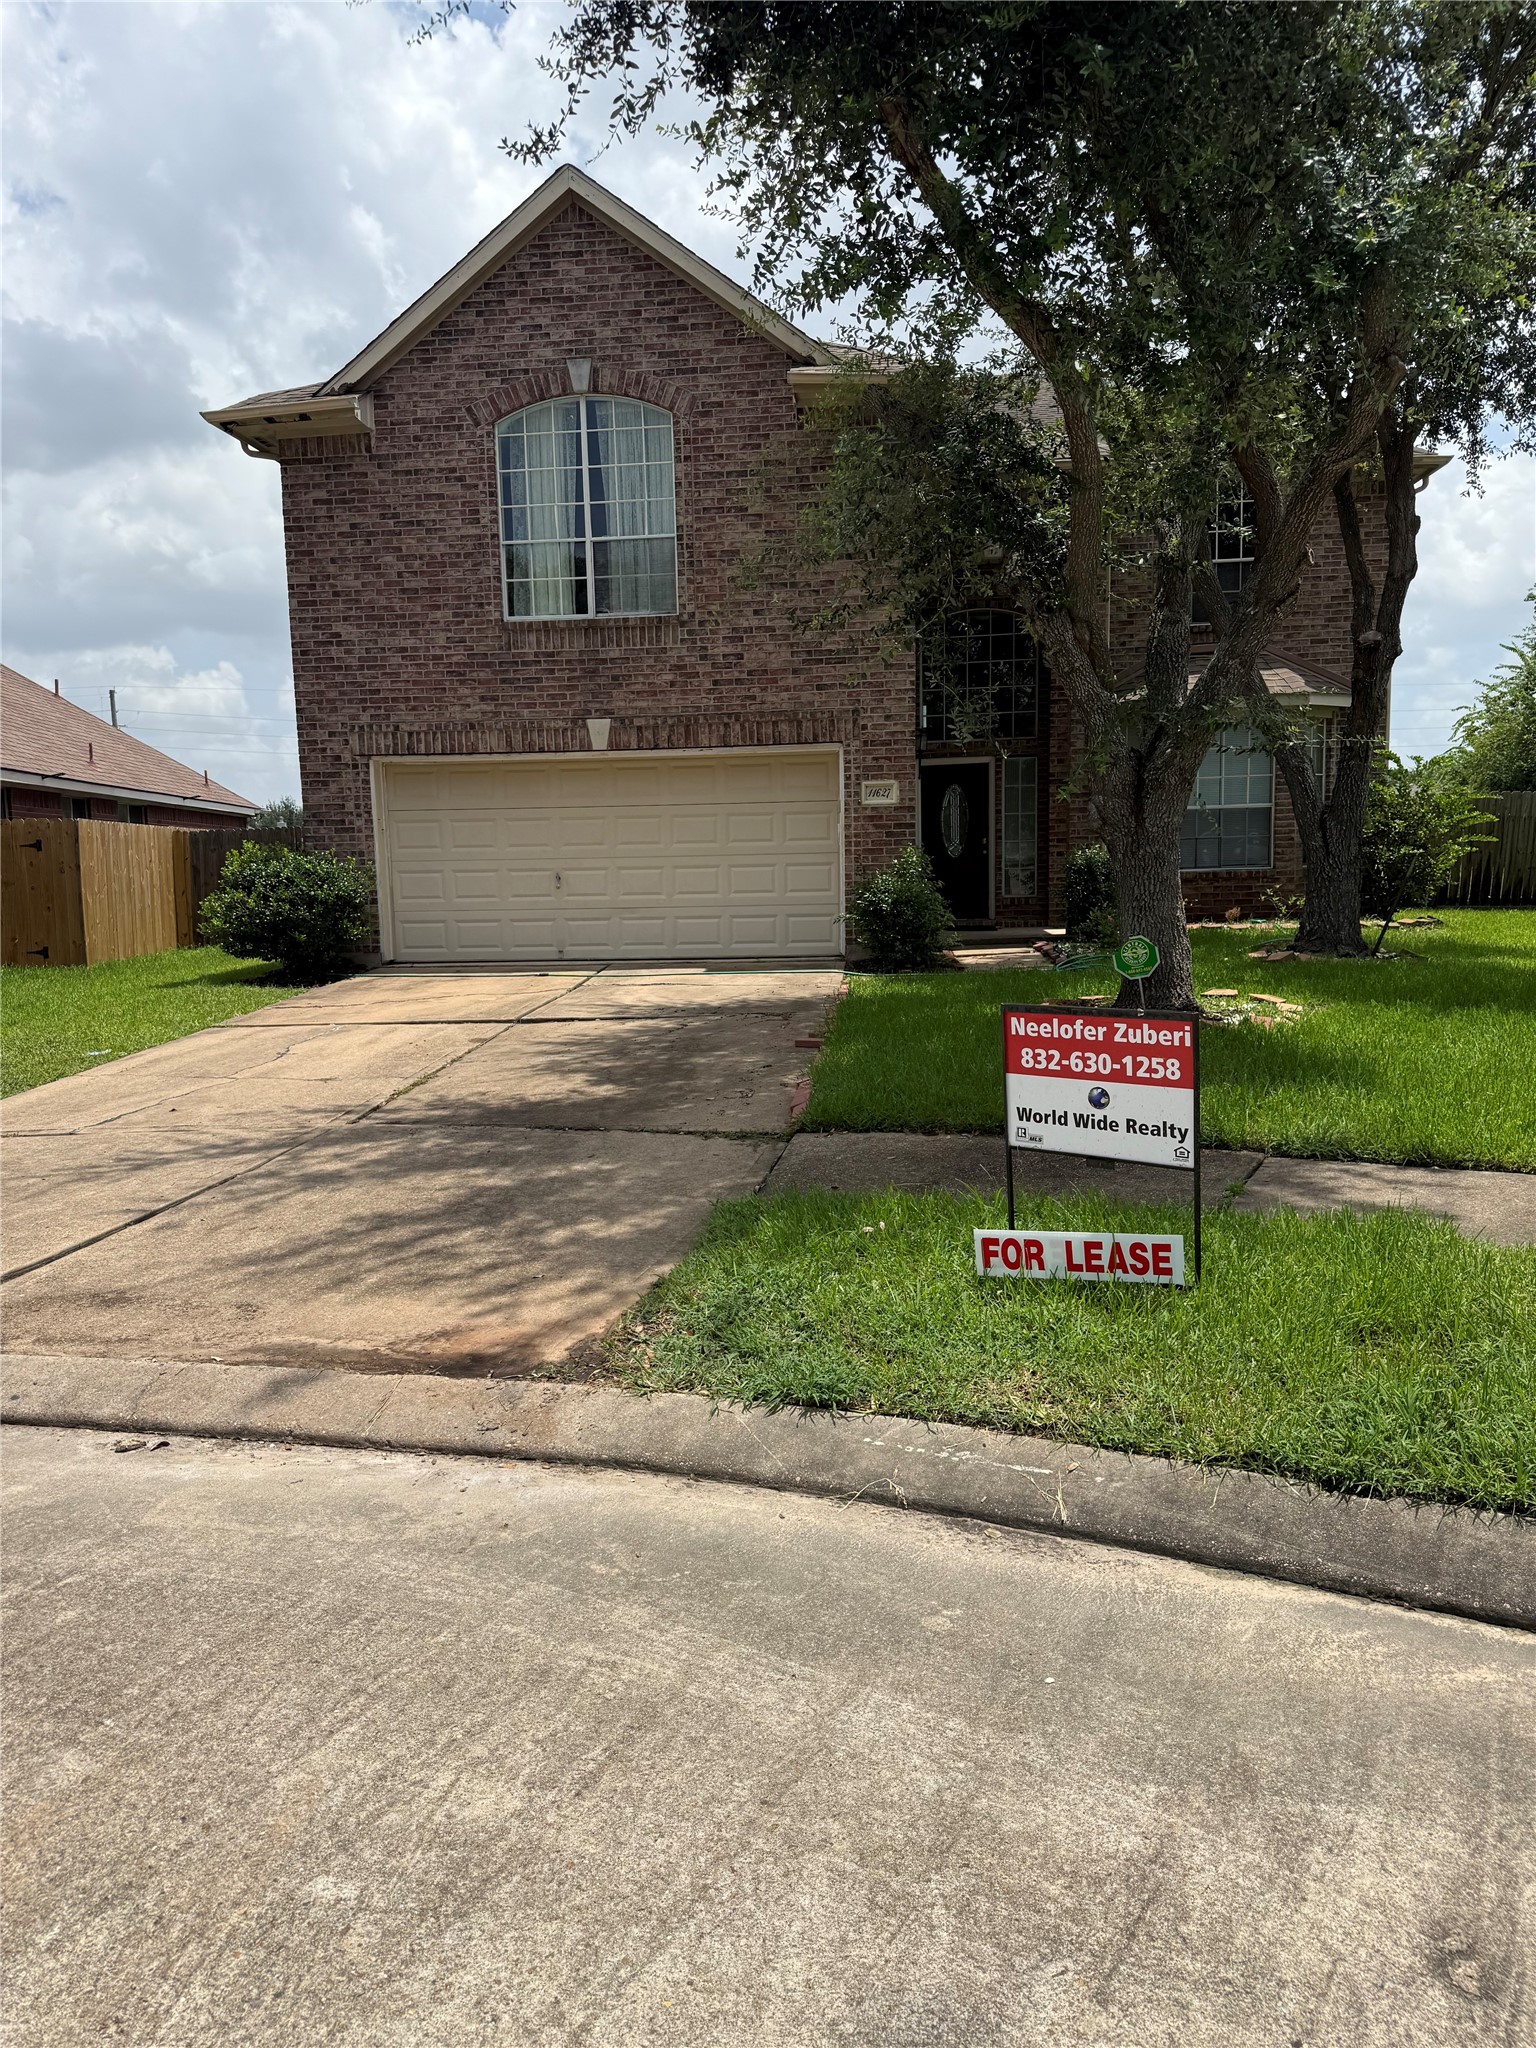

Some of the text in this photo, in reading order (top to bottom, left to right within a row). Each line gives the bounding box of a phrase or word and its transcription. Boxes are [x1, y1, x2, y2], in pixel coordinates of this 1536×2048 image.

[868, 787, 891, 798] 11627
[1010, 1016, 1191, 1047] Neelofer Zuberi
[1020, 1047, 1181, 1080] 832-630-1258
[1016, 1106, 1190, 1143] World Wide Realty
[981, 1237, 1173, 1276] FOR LEASE
